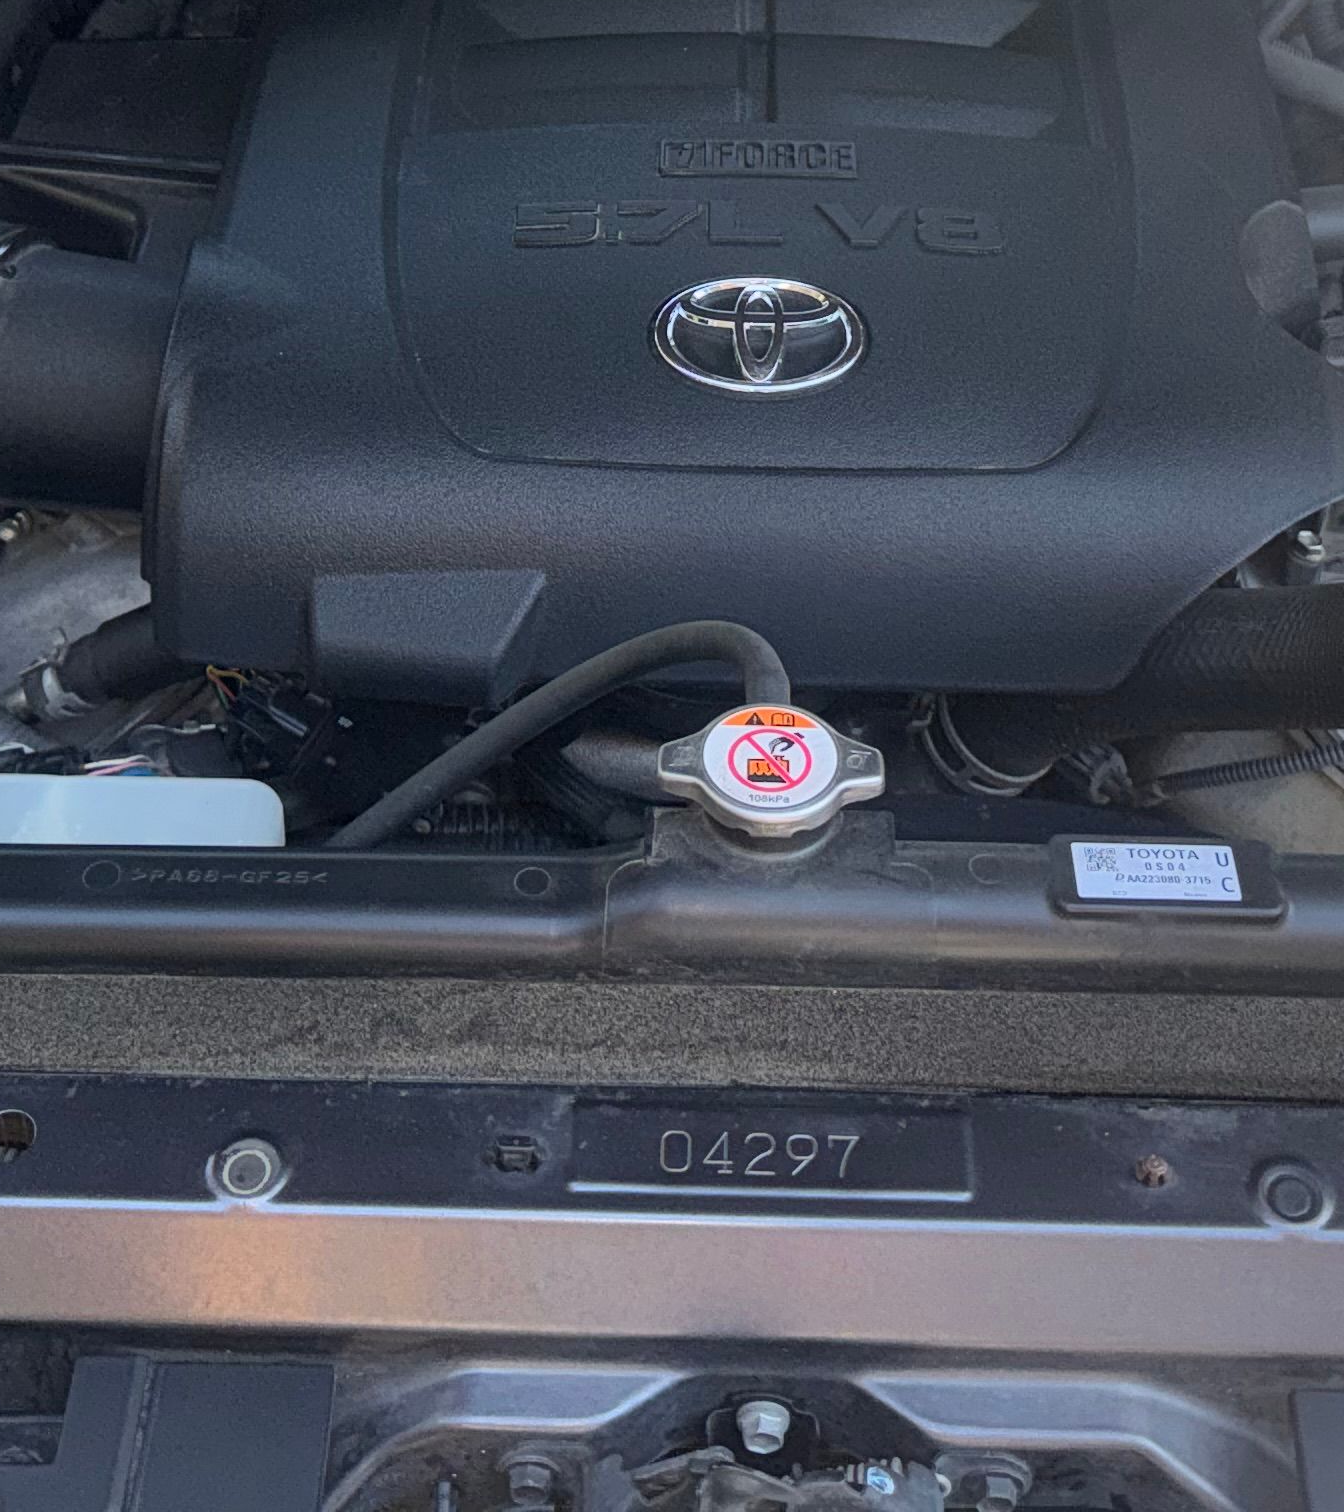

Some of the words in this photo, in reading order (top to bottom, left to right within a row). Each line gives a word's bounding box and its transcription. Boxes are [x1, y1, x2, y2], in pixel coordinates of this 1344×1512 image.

[512, 200, 783, 248] 5.7L
[813, 203, 1004, 256] V8
[1125, 847, 1200, 861] TOYOTA
[1214, 851, 1229, 868] U
[1221, 876, 1235, 893] C
[658, 1129, 861, 1179] 04297
